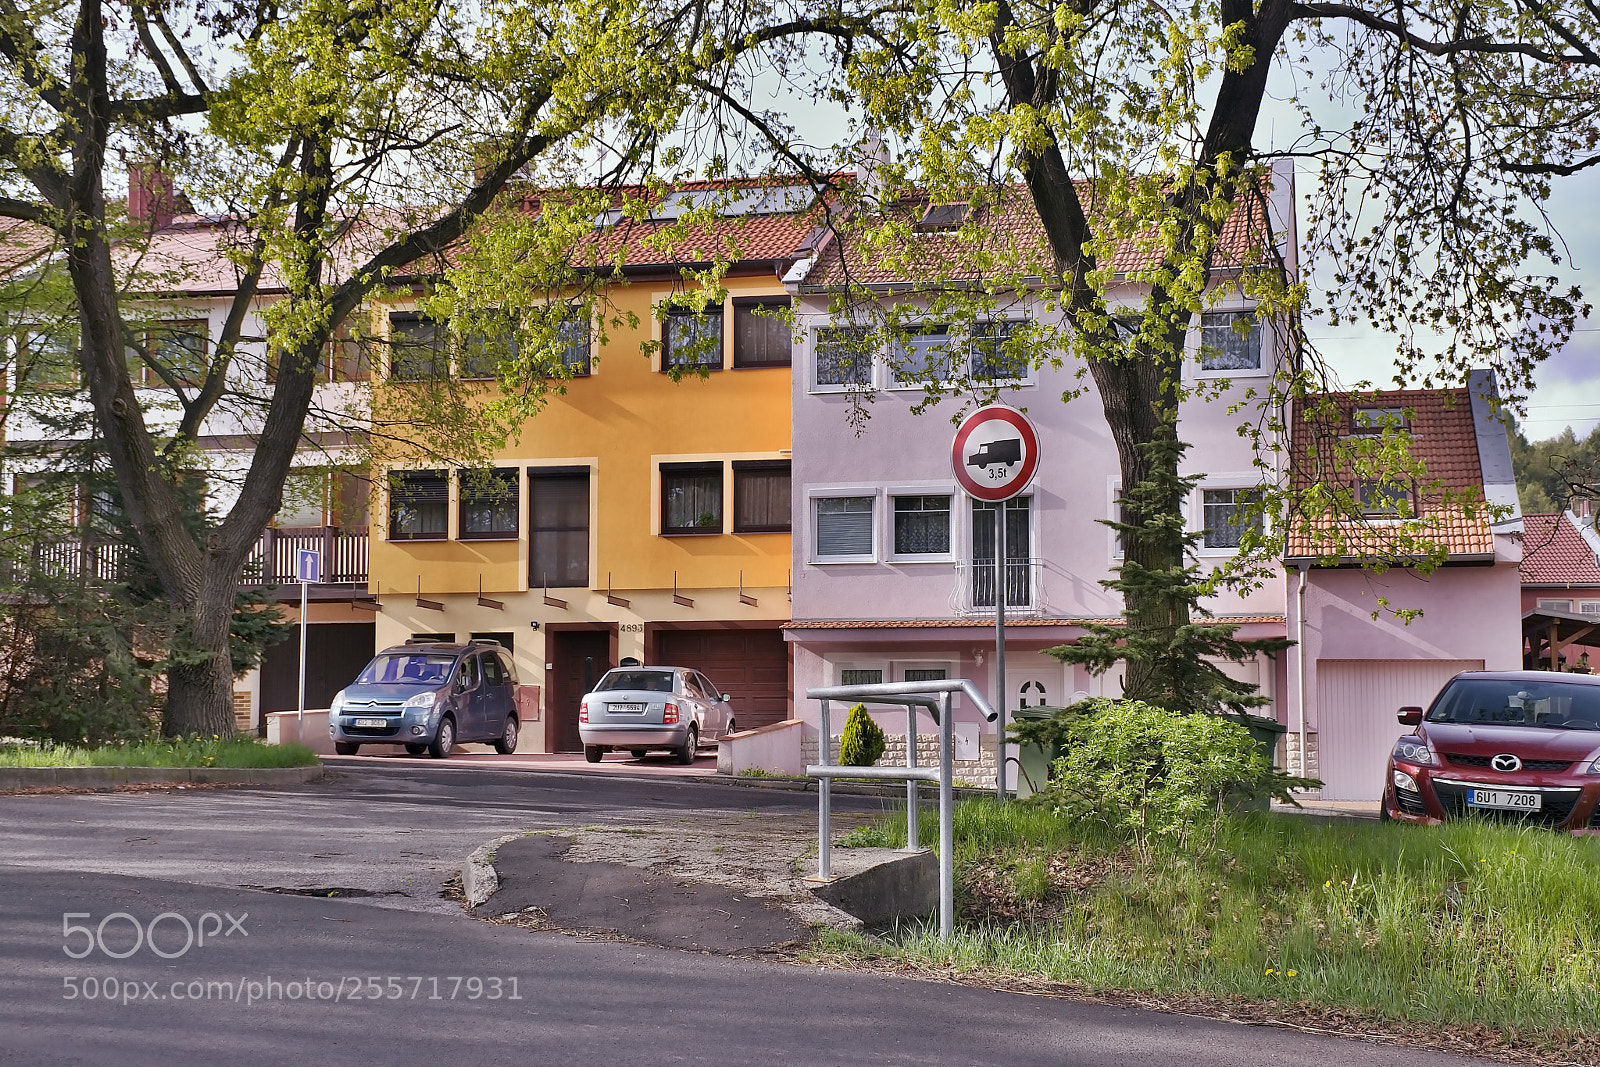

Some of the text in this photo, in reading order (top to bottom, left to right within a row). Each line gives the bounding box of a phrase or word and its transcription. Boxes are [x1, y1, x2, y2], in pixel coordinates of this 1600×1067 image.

[988, 468, 1007, 480] 3,5t
[1476, 792, 1497, 803] 6U1
[1507, 794, 1536, 806] 7208
